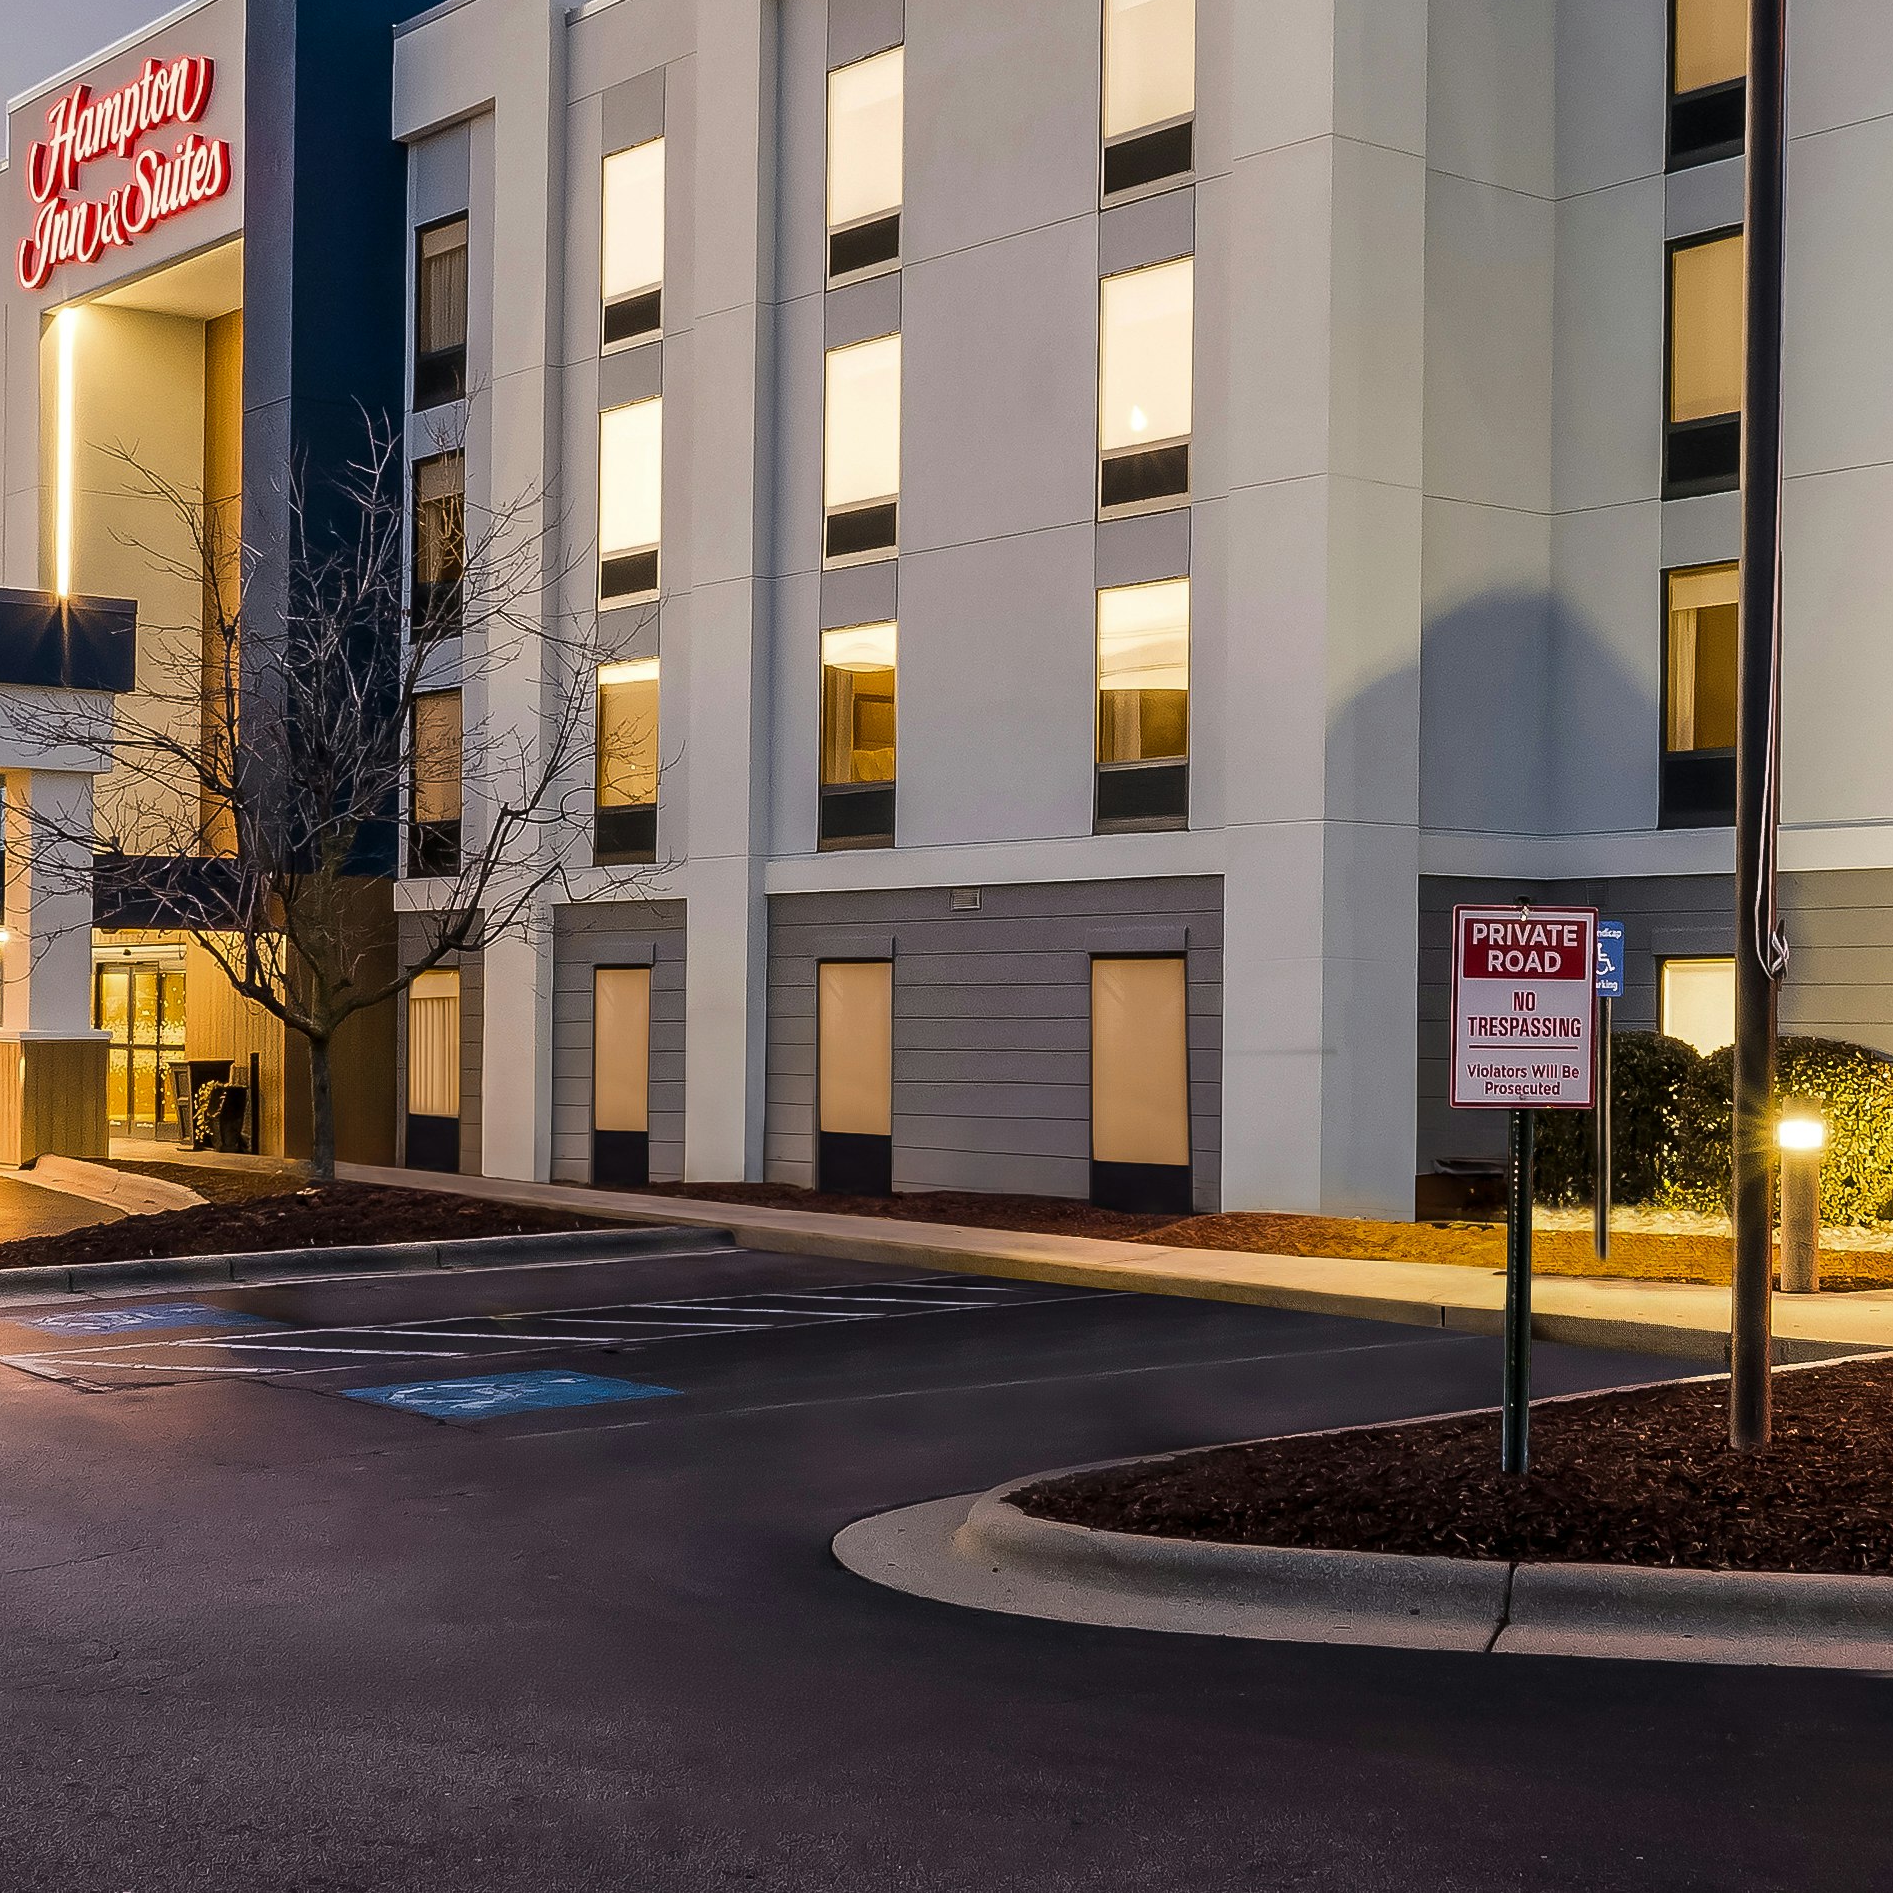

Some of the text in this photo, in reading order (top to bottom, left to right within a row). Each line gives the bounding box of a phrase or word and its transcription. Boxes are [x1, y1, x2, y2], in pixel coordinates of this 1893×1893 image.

[27, 56, 209, 204] Hampton
[18, 133, 226, 289] Inn & Suites
[1472, 923, 1578, 947] PRIVATE
[1487, 950, 1562, 973] ROAD
[1512, 991, 1537, 1012] NO
[1467, 1016, 1582, 1038] TRESPASSING
[1467, 1064, 1580, 1079] Violators Will Be
[1484, 1081, 1561, 1096] Prosecuted
